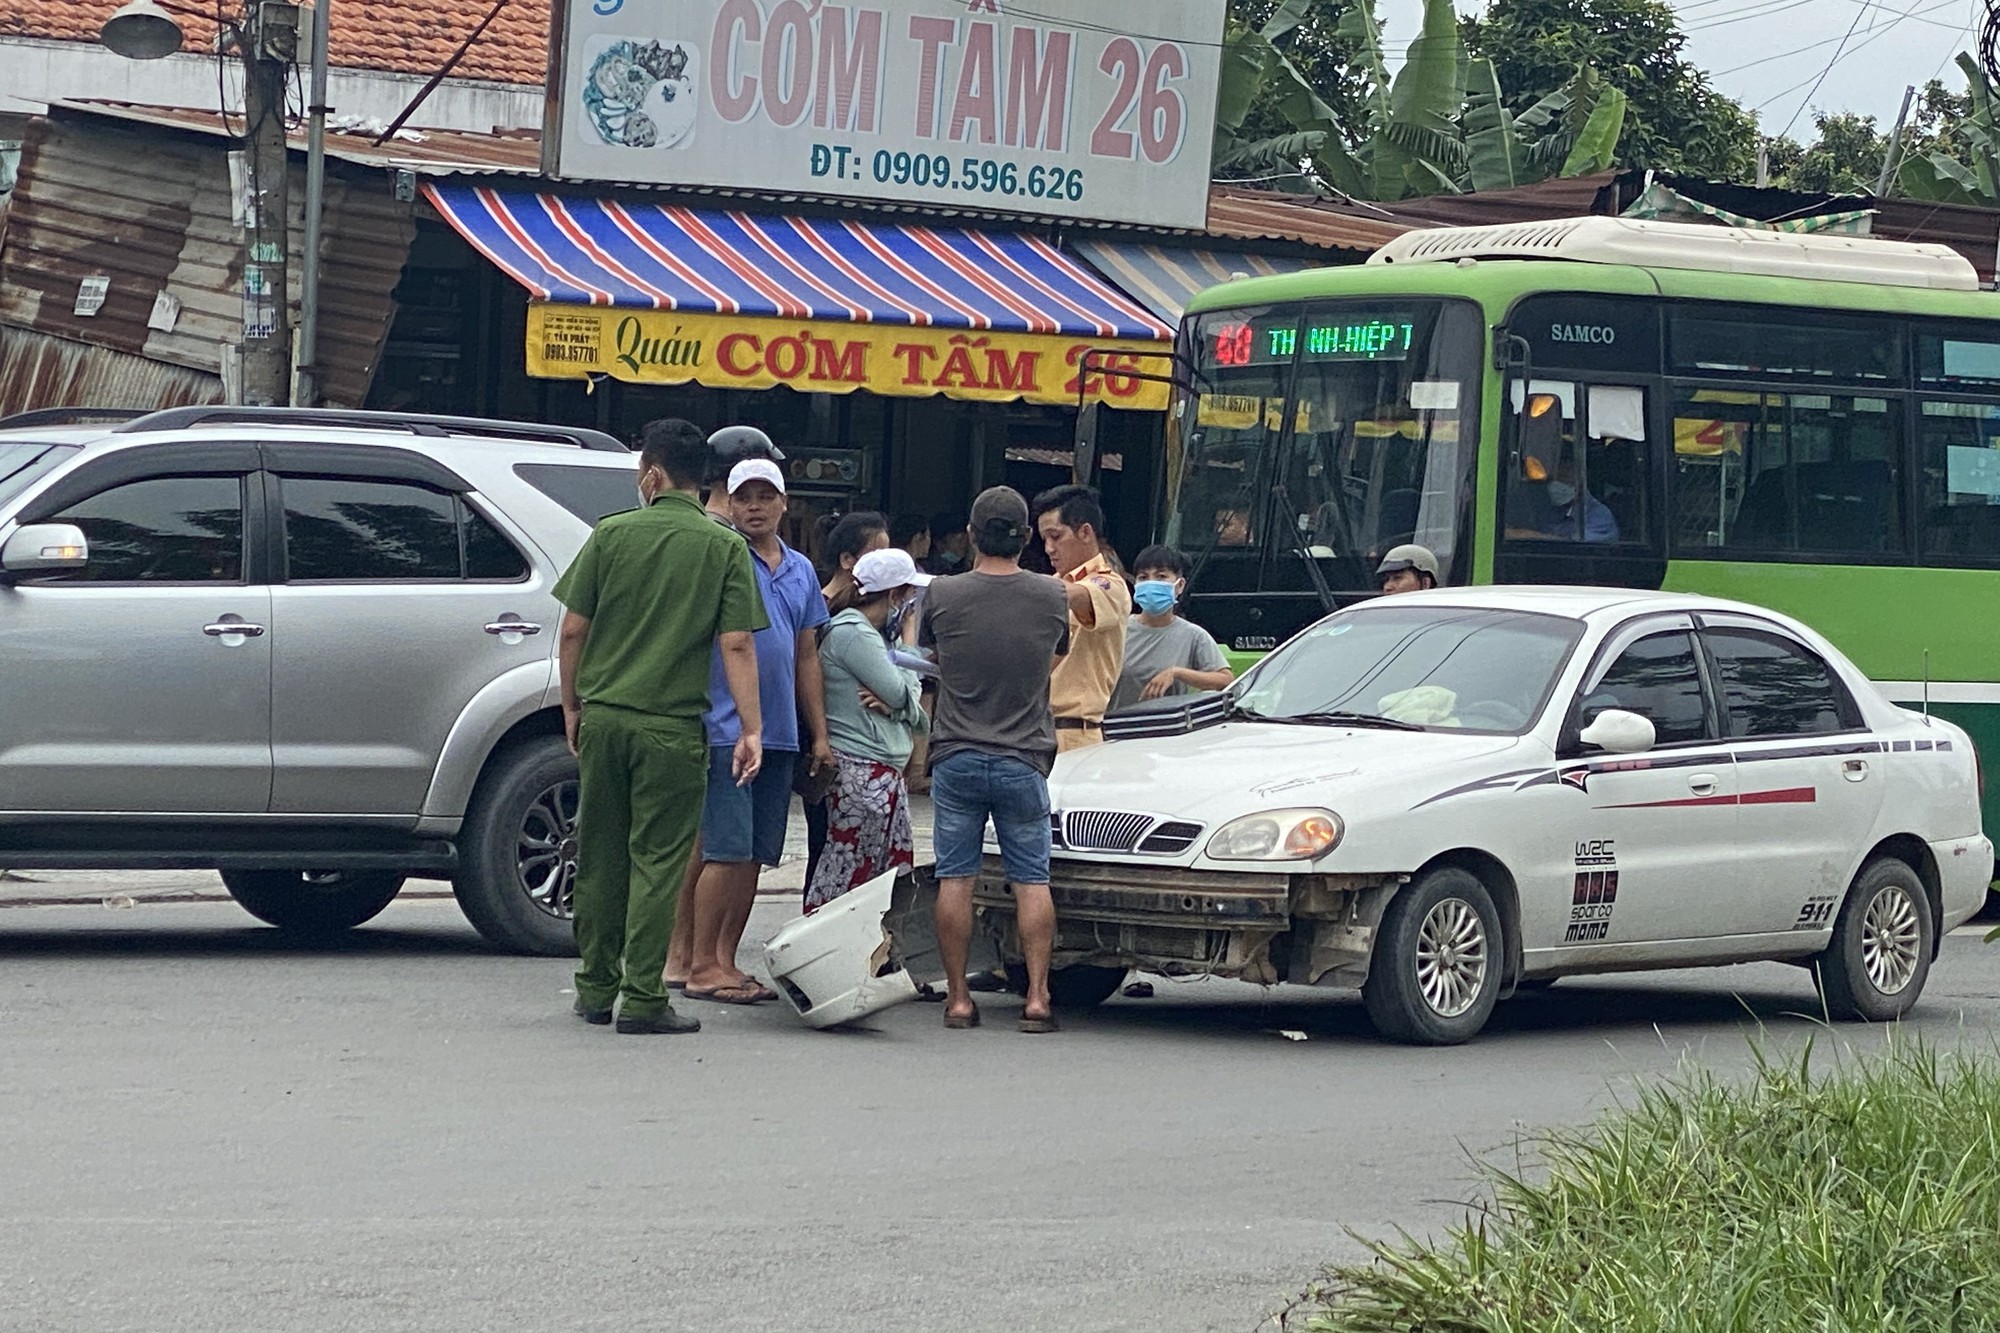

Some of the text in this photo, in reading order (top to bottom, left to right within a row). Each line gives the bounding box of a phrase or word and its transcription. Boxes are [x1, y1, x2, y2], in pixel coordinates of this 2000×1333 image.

[1090, 36, 1186, 164] 26
[811, 143, 1083, 202] ĐT: 0909.596.626
[616, 316, 1142, 398] Quán CƠM TẤM 26
[1551, 323, 1615, 344] SAMCO
[1571, 904, 1613, 920] sparco
